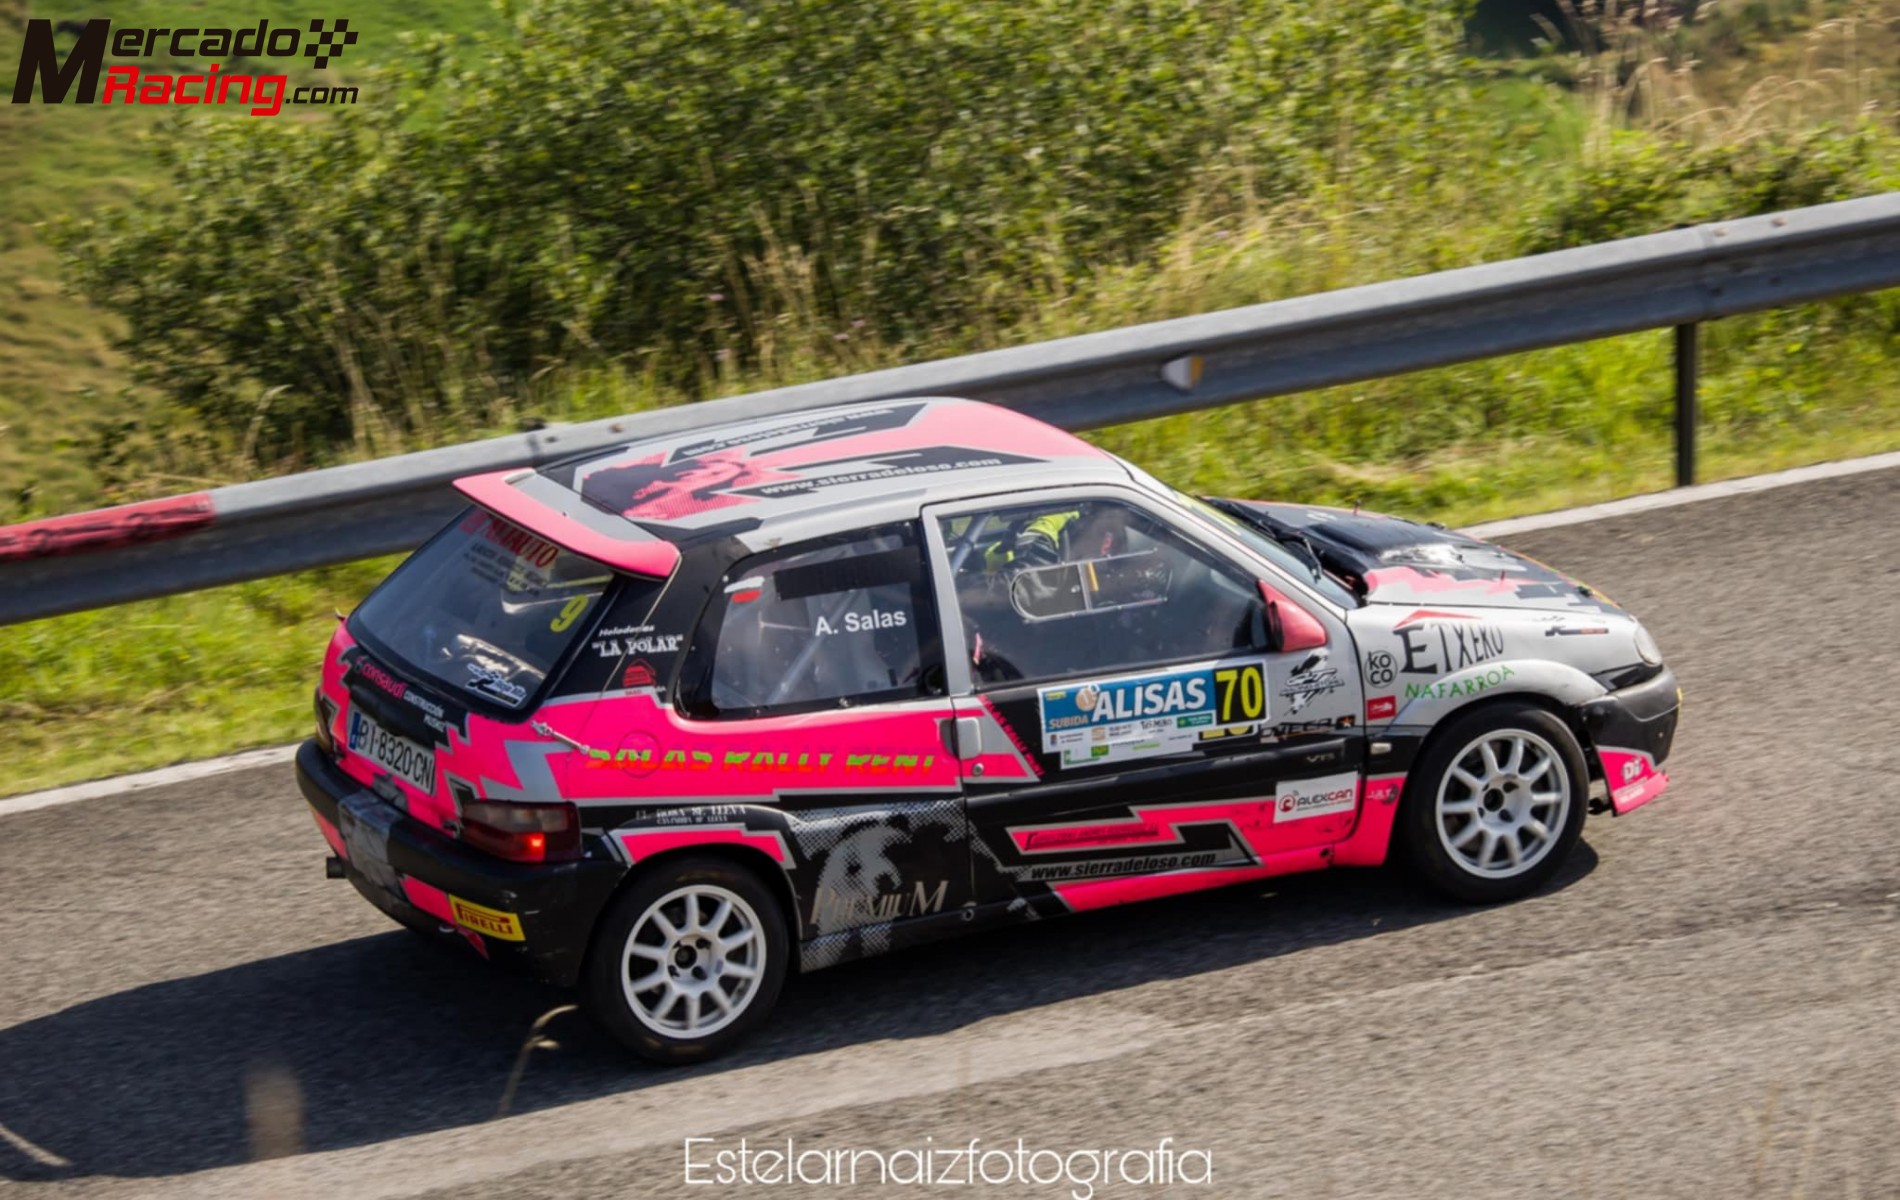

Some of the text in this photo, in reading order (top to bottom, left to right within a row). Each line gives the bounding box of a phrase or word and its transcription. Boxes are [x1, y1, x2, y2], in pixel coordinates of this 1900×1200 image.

[815, 609, 907, 636] A. Salas
[1215, 666, 1264, 721] 70
[1404, 664, 1515, 700] NAFARROA
[1091, 677, 1207, 722] ALISAS
[1031, 852, 1217, 879] www.sierradeloso.com
[456, 903, 514, 935] PIRELLI
